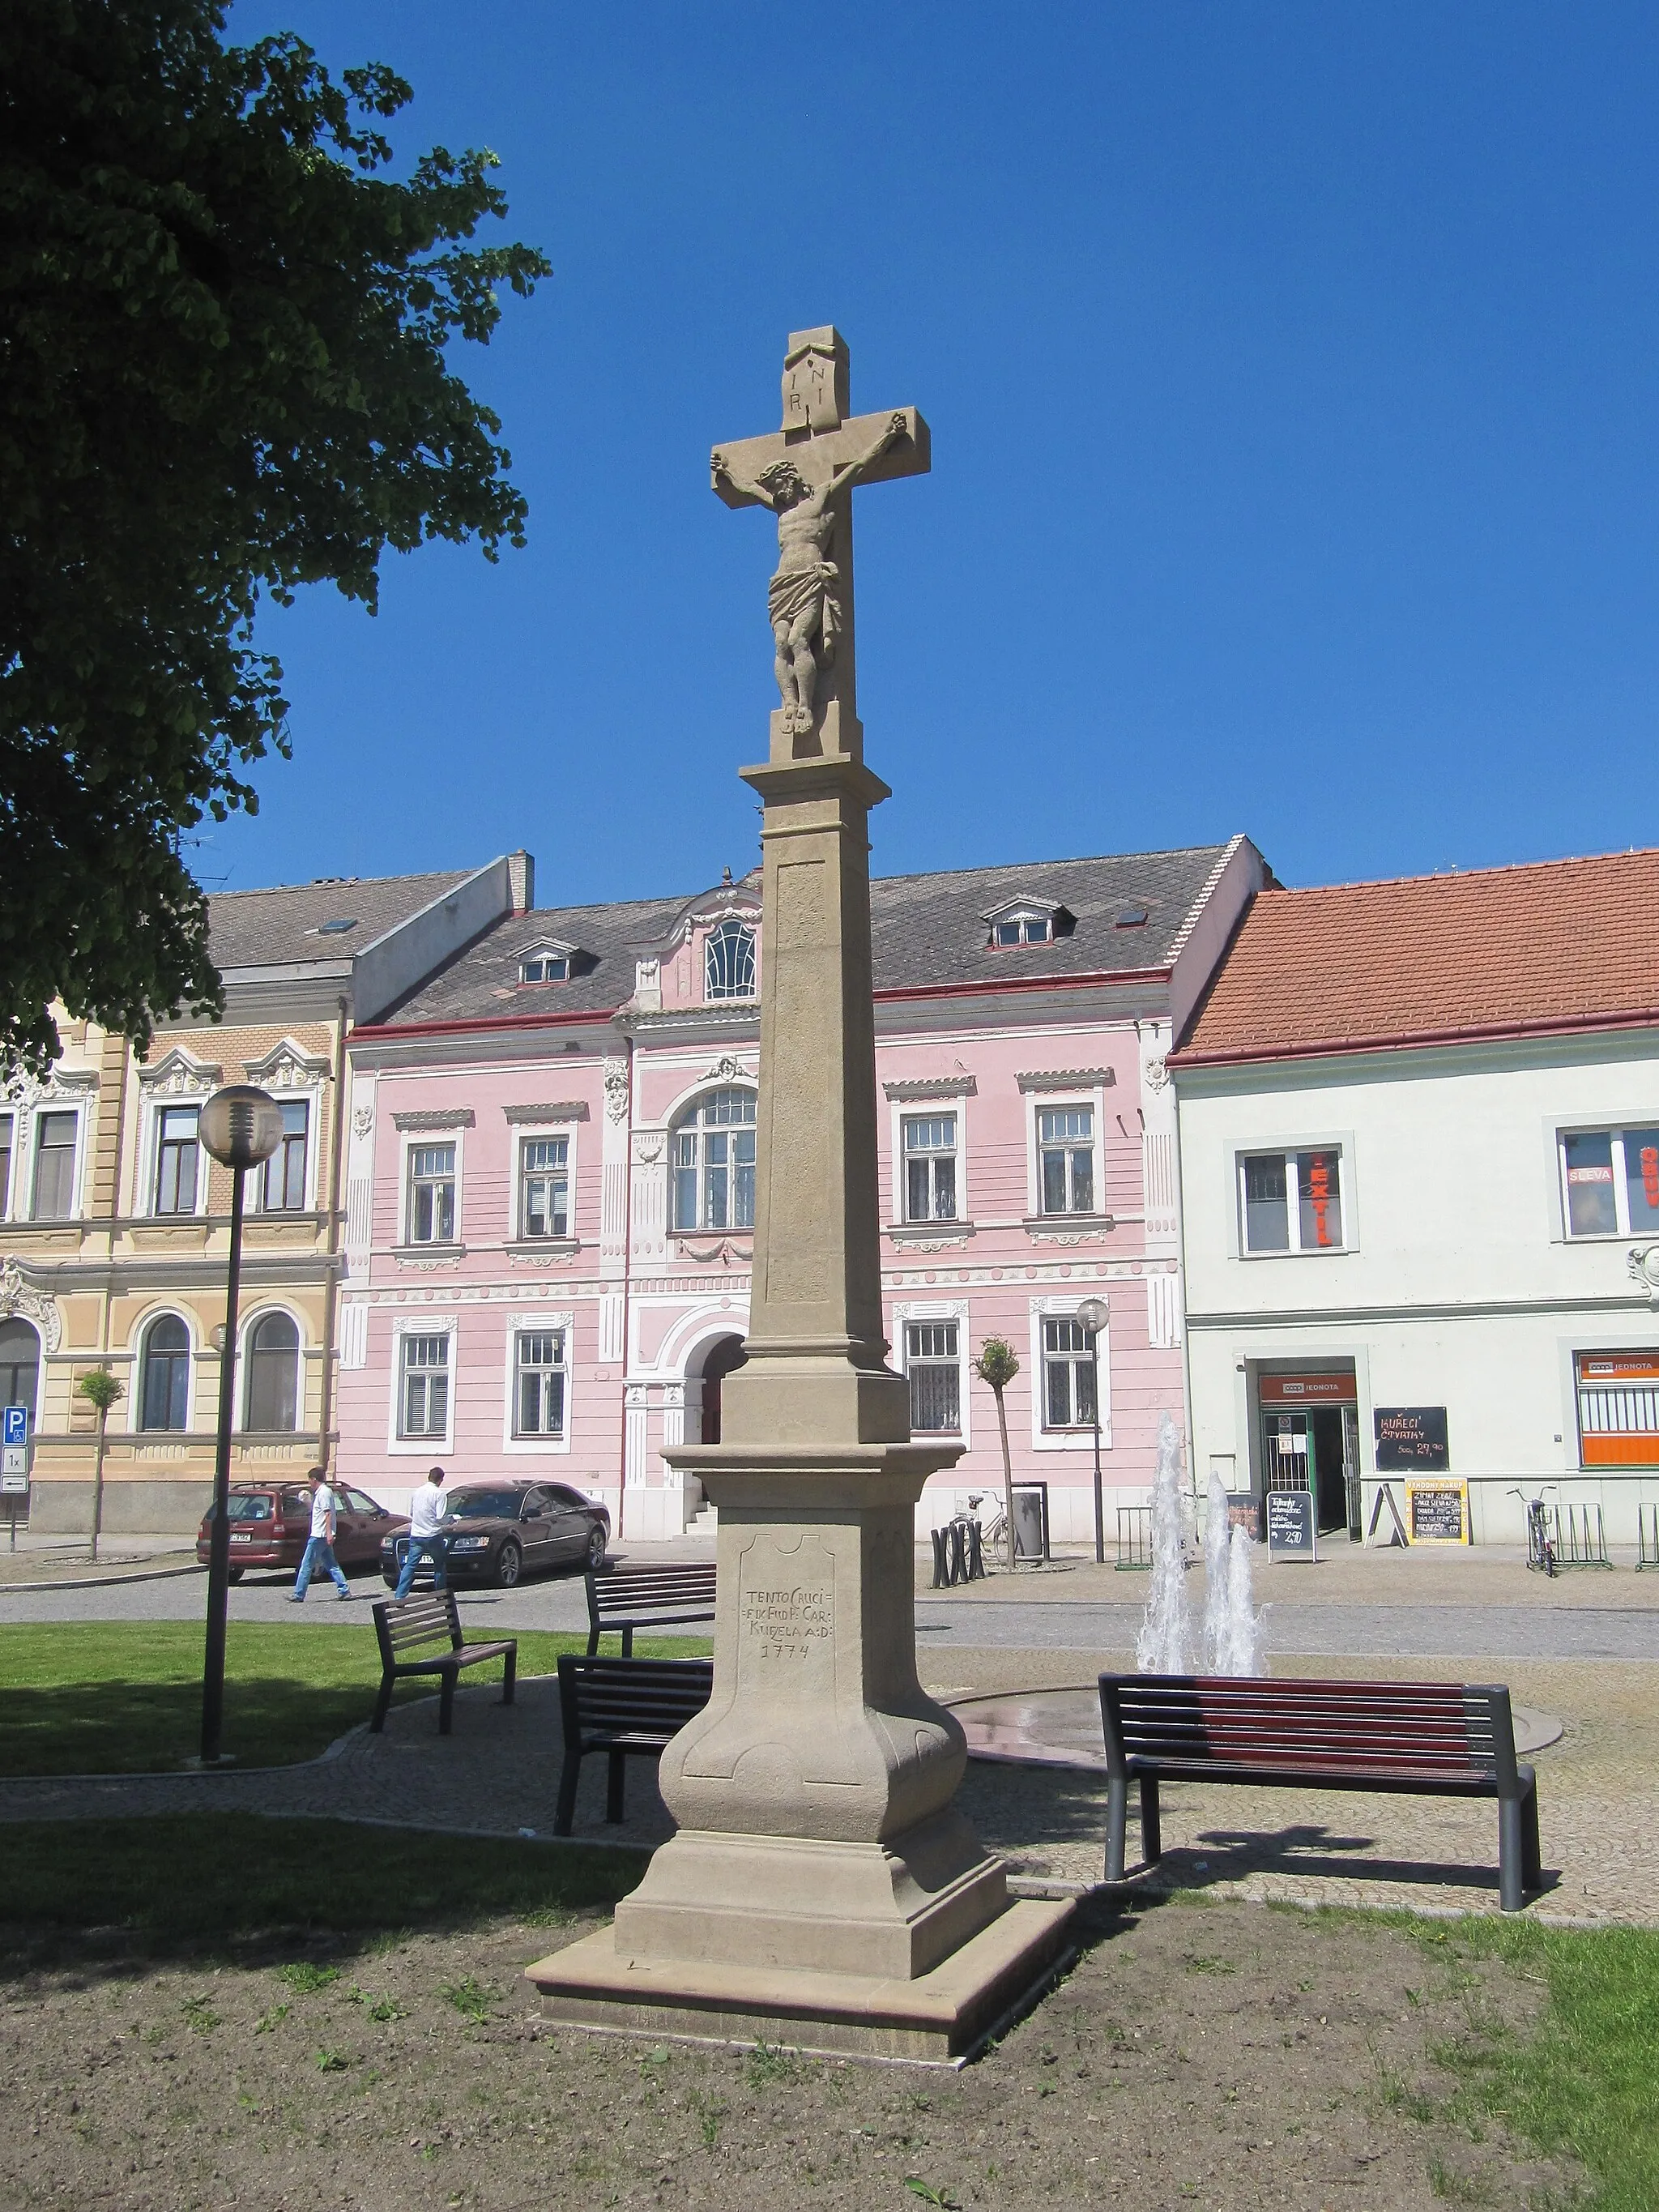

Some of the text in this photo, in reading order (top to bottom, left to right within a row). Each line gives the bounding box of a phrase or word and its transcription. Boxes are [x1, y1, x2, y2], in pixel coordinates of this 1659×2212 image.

[1569, 1171, 1611, 1181] SLEVA
[1614, 1363, 1653, 1371] JEDNOTA
[1305, 1383, 1339, 1391] JEDNOTA
[9, 1411, 23, 1433] P
[9, 1454, 19, 1467] 1x
[746, 1591, 789, 1603] TENTO
[761, 1645, 809, 1659] 1774
